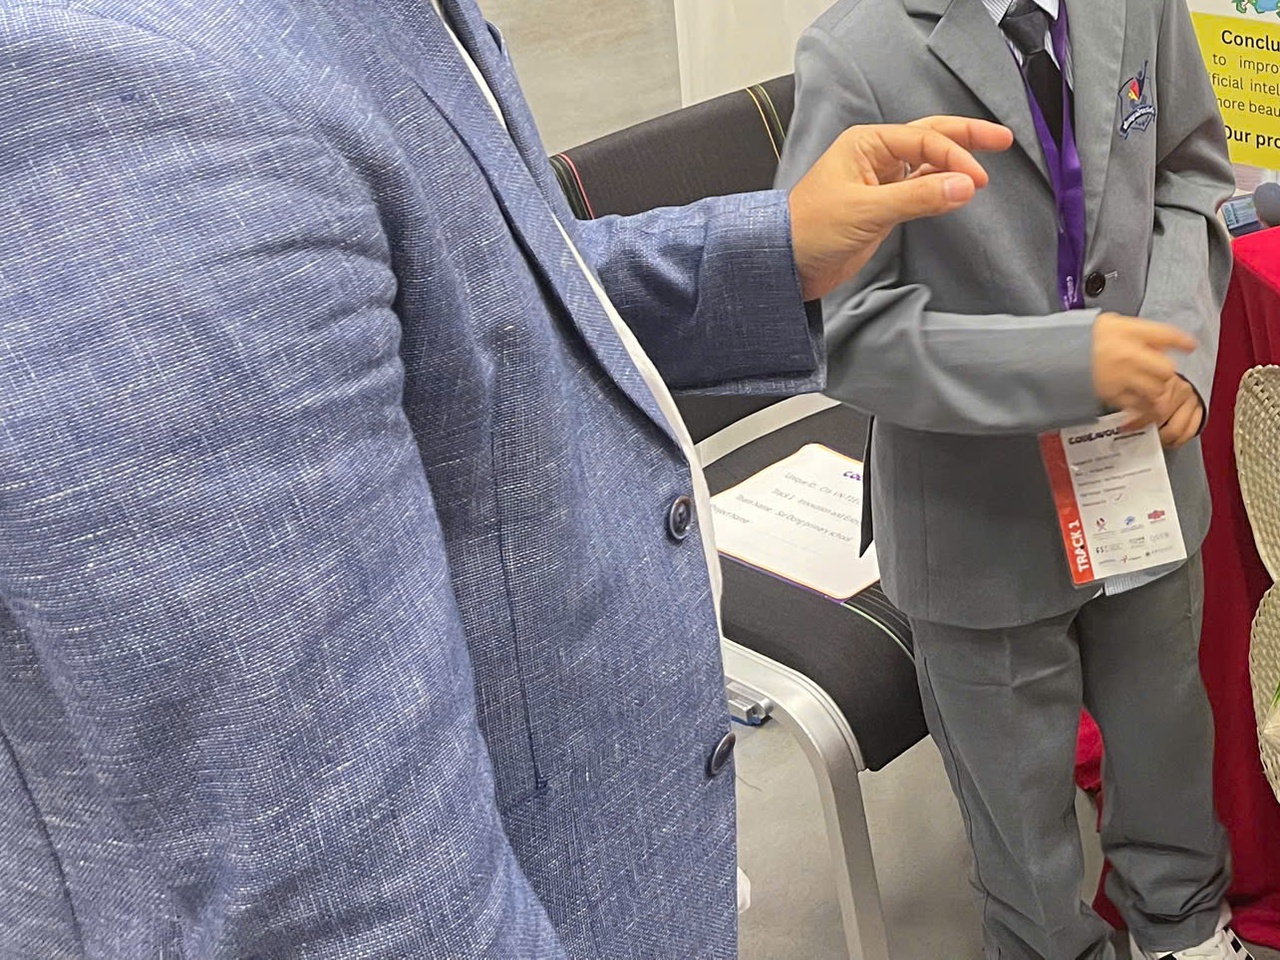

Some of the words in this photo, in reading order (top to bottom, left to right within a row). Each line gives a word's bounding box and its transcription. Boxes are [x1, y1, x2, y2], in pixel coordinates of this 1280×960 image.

[1212, 53, 1227, 66] to
[1209, 72, 1244, 90] ficial
[1224, 124, 1251, 143] Our
[1068, 520, 1080, 529] 1
[1072, 531, 1090, 572] TRACK
